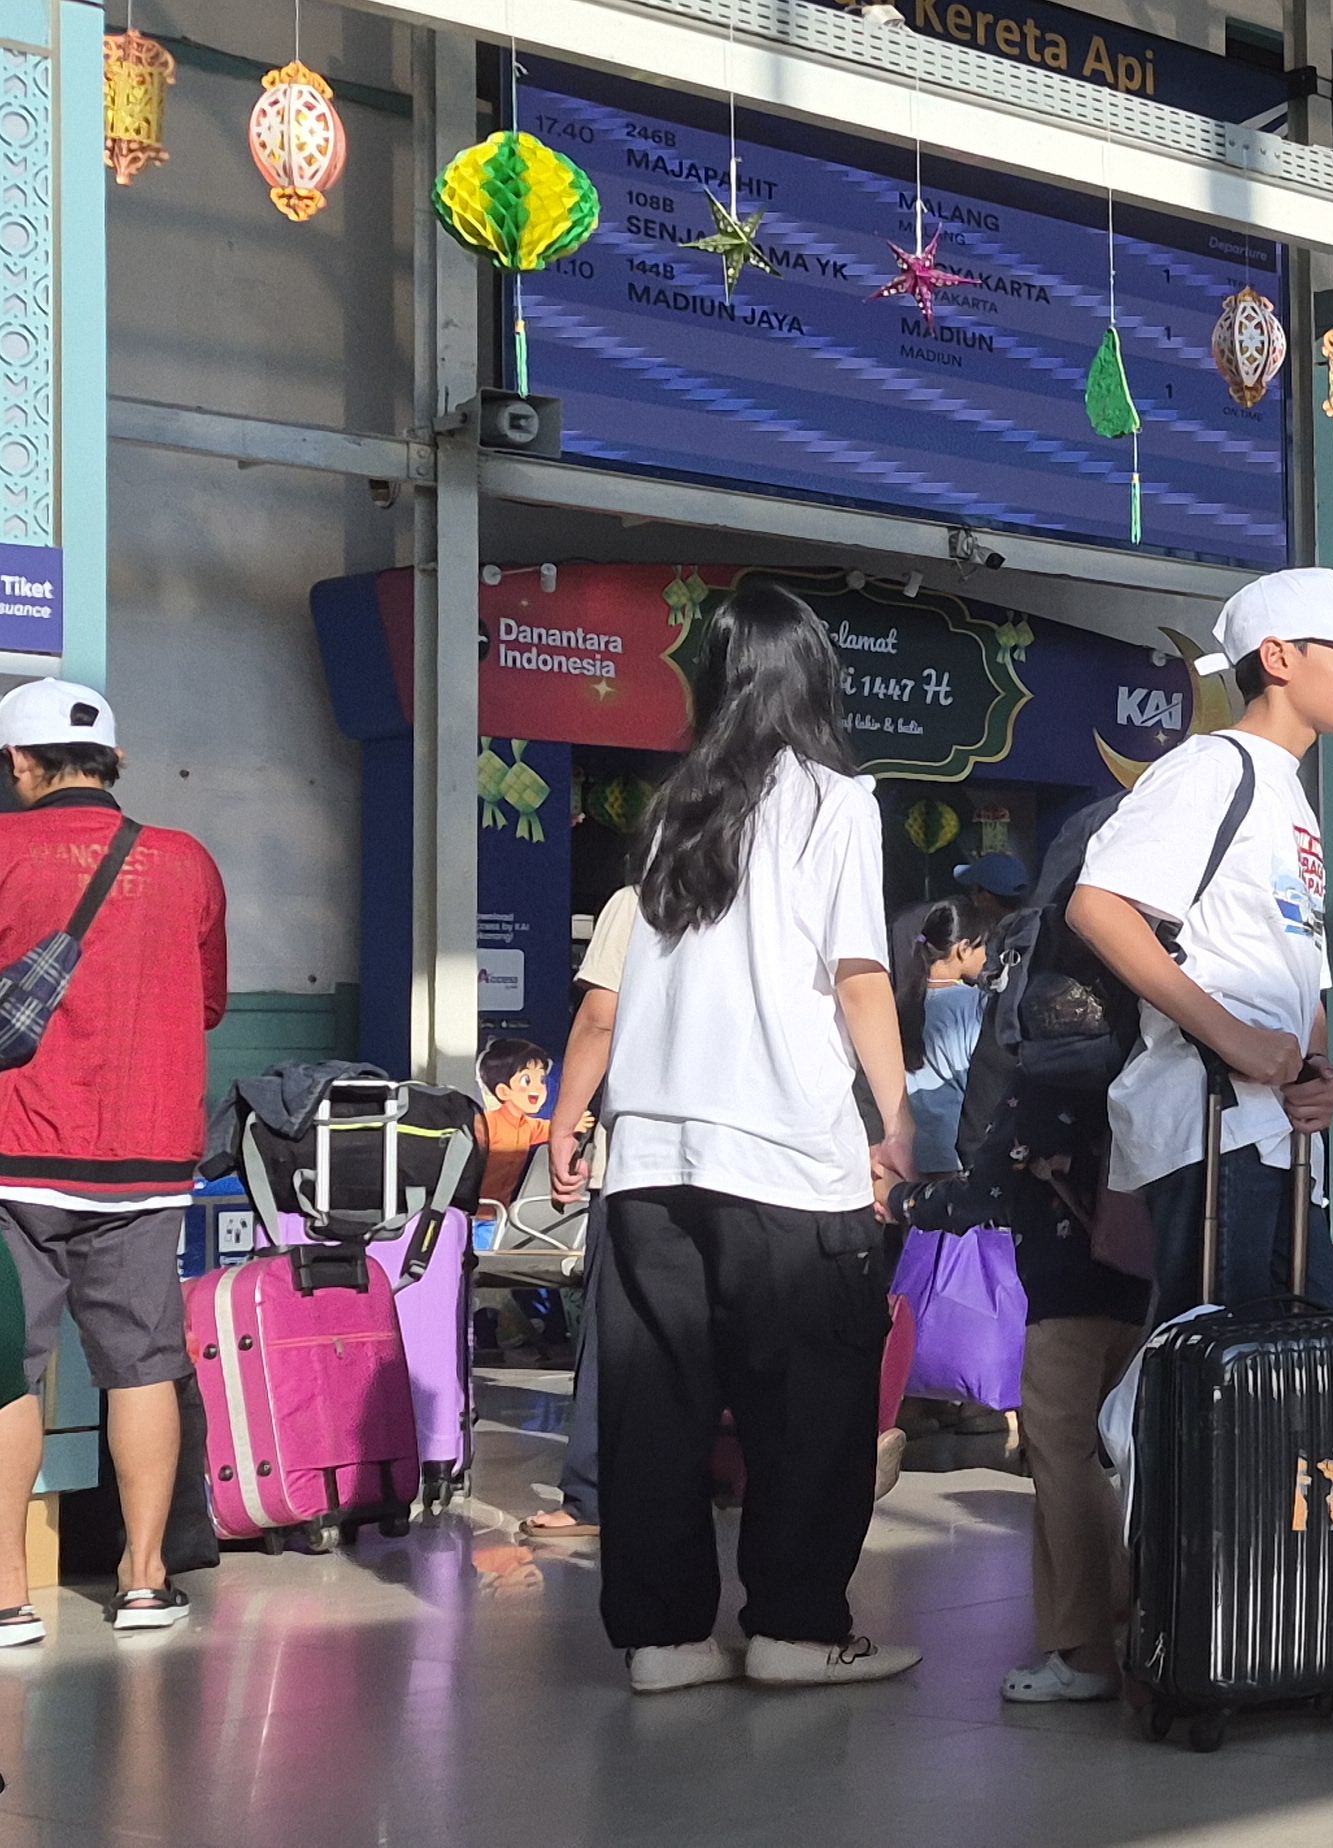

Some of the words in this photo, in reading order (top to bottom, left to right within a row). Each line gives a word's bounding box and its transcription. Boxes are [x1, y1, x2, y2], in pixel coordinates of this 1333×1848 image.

[913, 0, 1068, 72] Kereta
[1083, 33, 1156, 95] Api
[536, 114, 595, 144] 17.40
[626, 121, 677, 148] 246B
[626, 148, 778, 200] MAJAPAHIT
[627, 189, 675, 213] 108B
[899, 192, 1000, 232] MALANG
[899, 220, 966, 246] MLNG
[1208, 236, 1268, 262] Departure
[543, 257, 595, 280] 1.10
[627, 257, 676, 281] 144B
[816, 257, 849, 281] YK
[934, 262, 1051, 304] YAKARTA
[627, 282, 736, 322] MADIUN
[743, 307, 806, 336] JAYA
[901, 316, 994, 353] MADIUN
[901, 343, 963, 368] MADIUN
[0, 574, 55, 599] Tiket
[499, 617, 623, 653] Danantara
[499, 643, 616, 678] Indonesia
[860, 675, 916, 702] 1447
[922, 668, 954, 706] H
[1116, 686, 1184, 731] KAI
